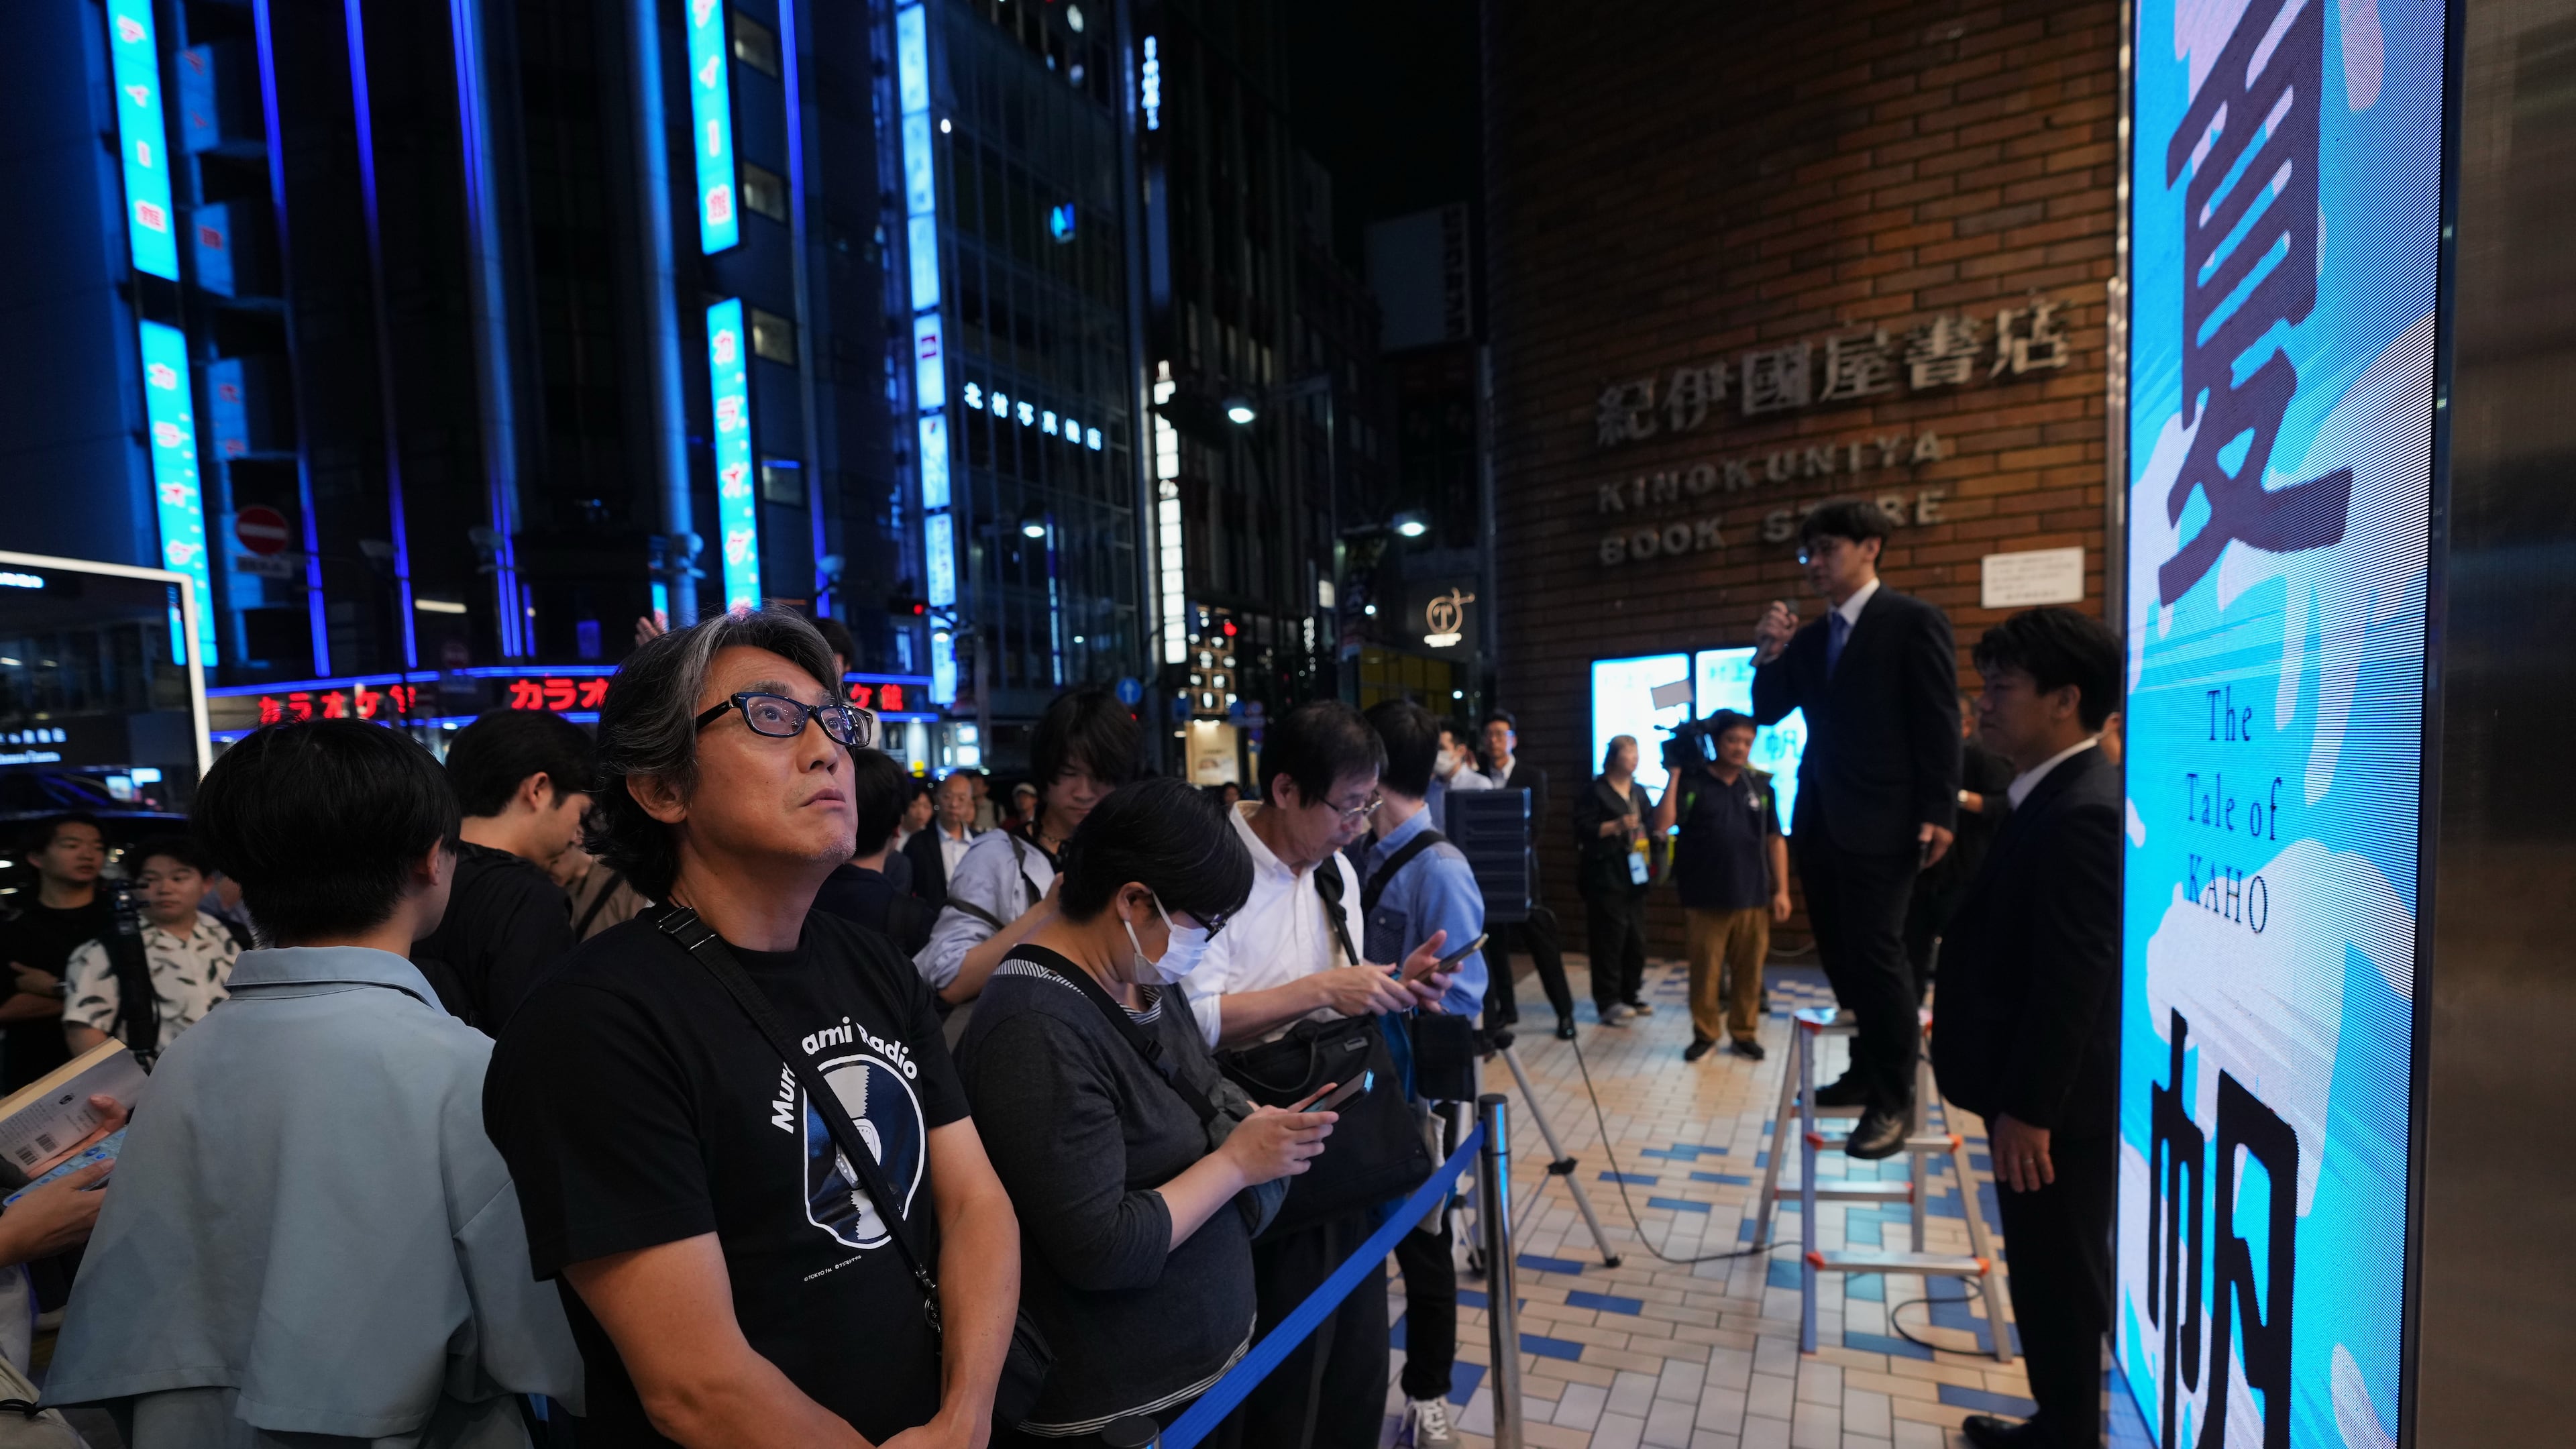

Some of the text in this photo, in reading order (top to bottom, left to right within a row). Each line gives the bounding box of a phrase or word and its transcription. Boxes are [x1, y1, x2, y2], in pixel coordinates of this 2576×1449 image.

[2159, 0, 2354, 608] 夏
[1597, 297, 2074, 447] 紀伊國屋書店
[148, 362, 199, 567] カラオケ
[1598, 429, 1941, 515] KINOKUNIYA
[1599, 489, 1947, 568] BOOK SRE
[509, 678, 610, 711] カラオ
[2206, 685, 2253, 742] The
[2187, 772, 2283, 841] Tale of
[2189, 853, 2268, 934] KAHO
[771, 1016, 918, 1134] Murami Radio
